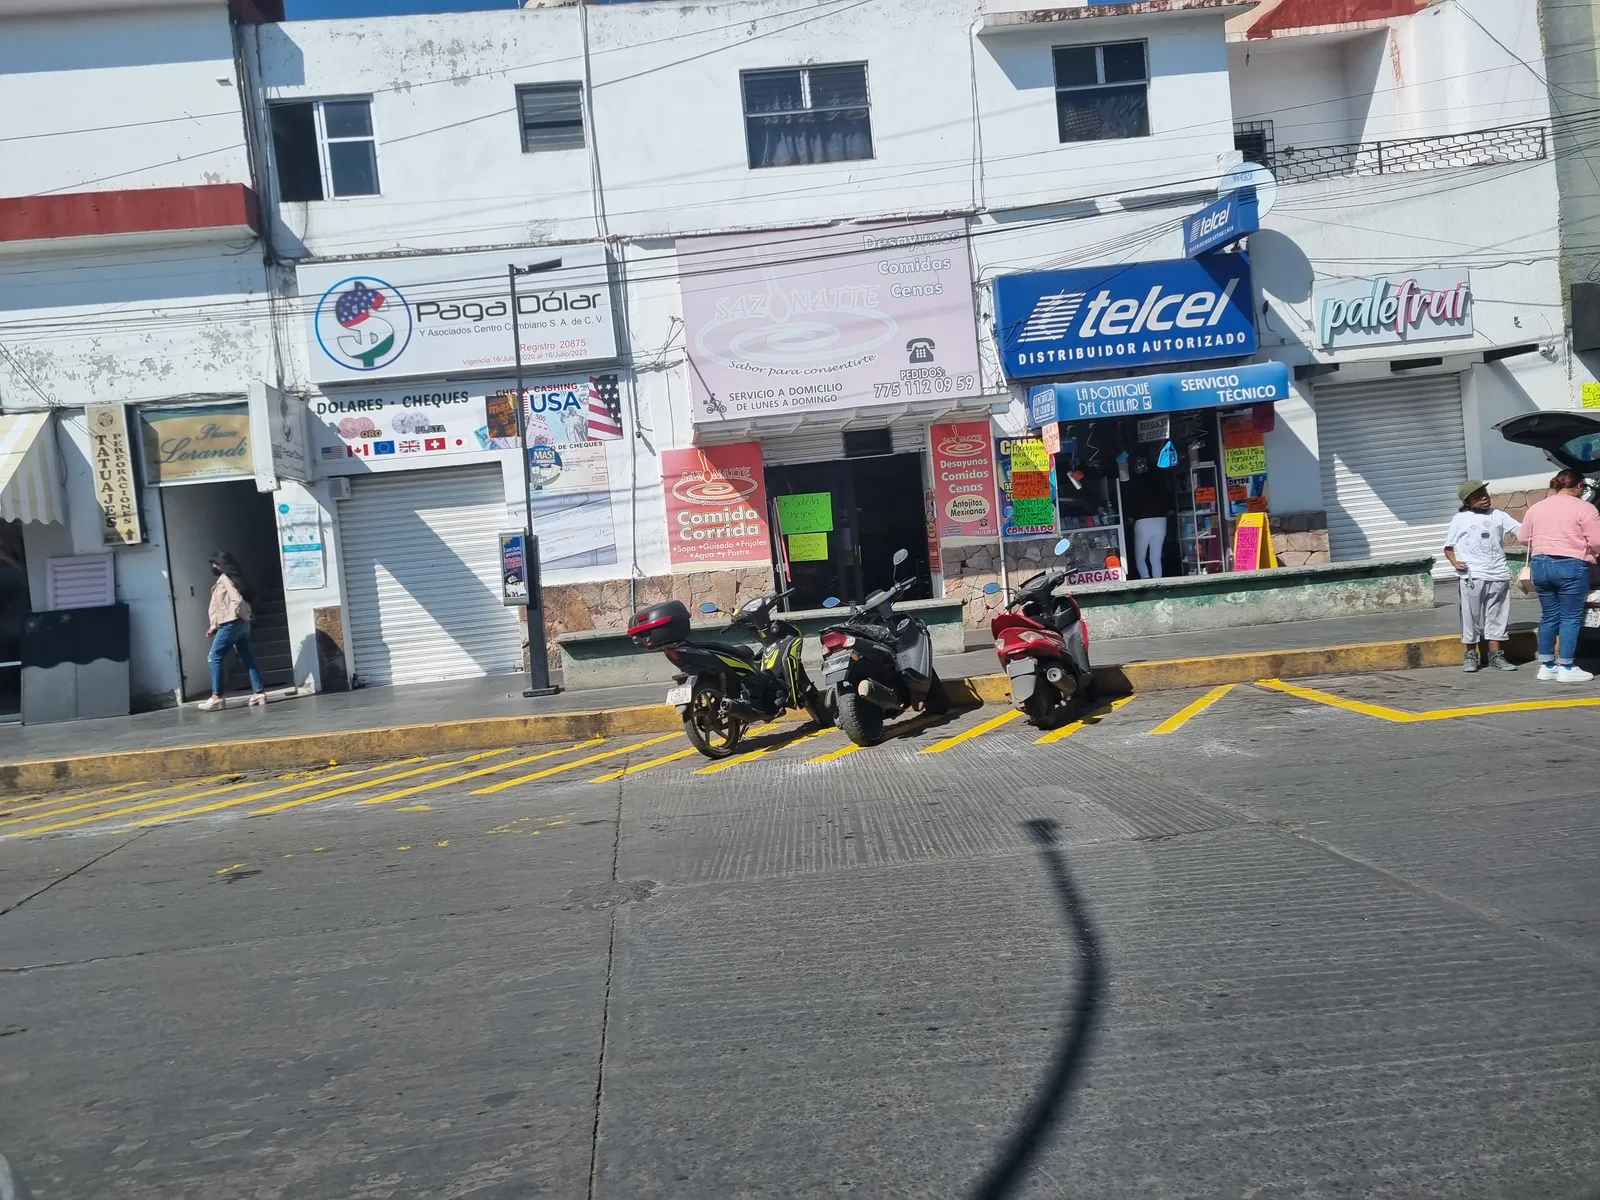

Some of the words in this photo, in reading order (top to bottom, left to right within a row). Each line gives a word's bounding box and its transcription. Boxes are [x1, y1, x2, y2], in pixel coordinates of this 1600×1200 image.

[1199, 202, 1231, 237] telcel
[863, 231, 960, 252] Desayunos
[878, 256, 951, 275] Comidas
[890, 283, 943, 298] Cenas
[415, 301, 507, 322] Paga
[517, 290, 602, 315] Dólar
[1079, 278, 1240, 338] telcel
[1321, 277, 1469, 345] palefrut
[419, 329, 426, 337] Y
[428, 327, 471, 337] Asociados
[474, 324, 503, 333] Centro
[549, 319, 558, 327] S.
[560, 319, 569, 327] A.
[572, 316, 582, 325] de
[584, 316, 594, 324] C.
[596, 315, 604, 323] V.
[520, 342, 555, 353] Registro
[559, 339, 586, 349] 20875
[1018, 341, 1136, 365] DISTRIBUIDOR
[1143, 331, 1246, 353] AUTORIZADO
[462, 356, 491, 366] Vigencia
[728, 360, 767, 373] Sabor
[768, 367, 801, 377] para
[803, 353, 877, 375] consentirte
[900, 366, 946, 380] PEDIDOS:
[534, 383, 578, 393] CASHING
[873, 382, 901, 398] 775
[905, 379, 931, 395] 112
[935, 377, 952, 393] 09
[957, 375, 974, 391] 59
[1076, 388, 1088, 400] LA
[1090, 382, 1150, 400] BOUTIQUE
[1181, 374, 1239, 391] SERVICIO
[728, 389, 774, 401] SERVICIO
[778, 388, 785, 397] A
[789, 383, 842, 396] DOMICILIO
[1216, 385, 1276, 402] TÉCNICO
[317, 398, 383, 415] DOLARES
[402, 391, 469, 408] CHEQUES
[530, 391, 581, 413] USA
[736, 403, 748, 411] DE
[751, 401, 779, 410] LUNES
[791, 394, 838, 406] DOMINGO
[1079, 401, 1097, 416] DEL
[1100, 398, 1139, 413] CELULAR
[195, 422, 238, 440] Plaza
[360, 429, 382, 438] ORO
[415, 425, 446, 434] PLATA
[158, 436, 248, 464] Lorandi
[569, 441, 603, 449] CHEQUES
[940, 458, 988, 468] Desayunos
[95, 434, 117, 528] TATUAJES
[112, 433, 132, 524] PERFORACIONES
[941, 470, 988, 481] Comidas
[949, 483, 983, 493] Cenas
[950, 508, 986, 517] Mexicanos
[952, 499, 983, 509] Antojitos
[677, 505, 759, 525] Comida
[679, 523, 761, 541] Corrida
[1006, 526, 1025, 535] CON
[1025, 525, 1054, 534] SALDO
[677, 545, 696, 553] Sopa
[703, 542, 734, 550] Guisado
[740, 539, 767, 548] Frijoles
[694, 552, 714, 560] Agua
[1068, 570, 1120, 585] CARGAS
